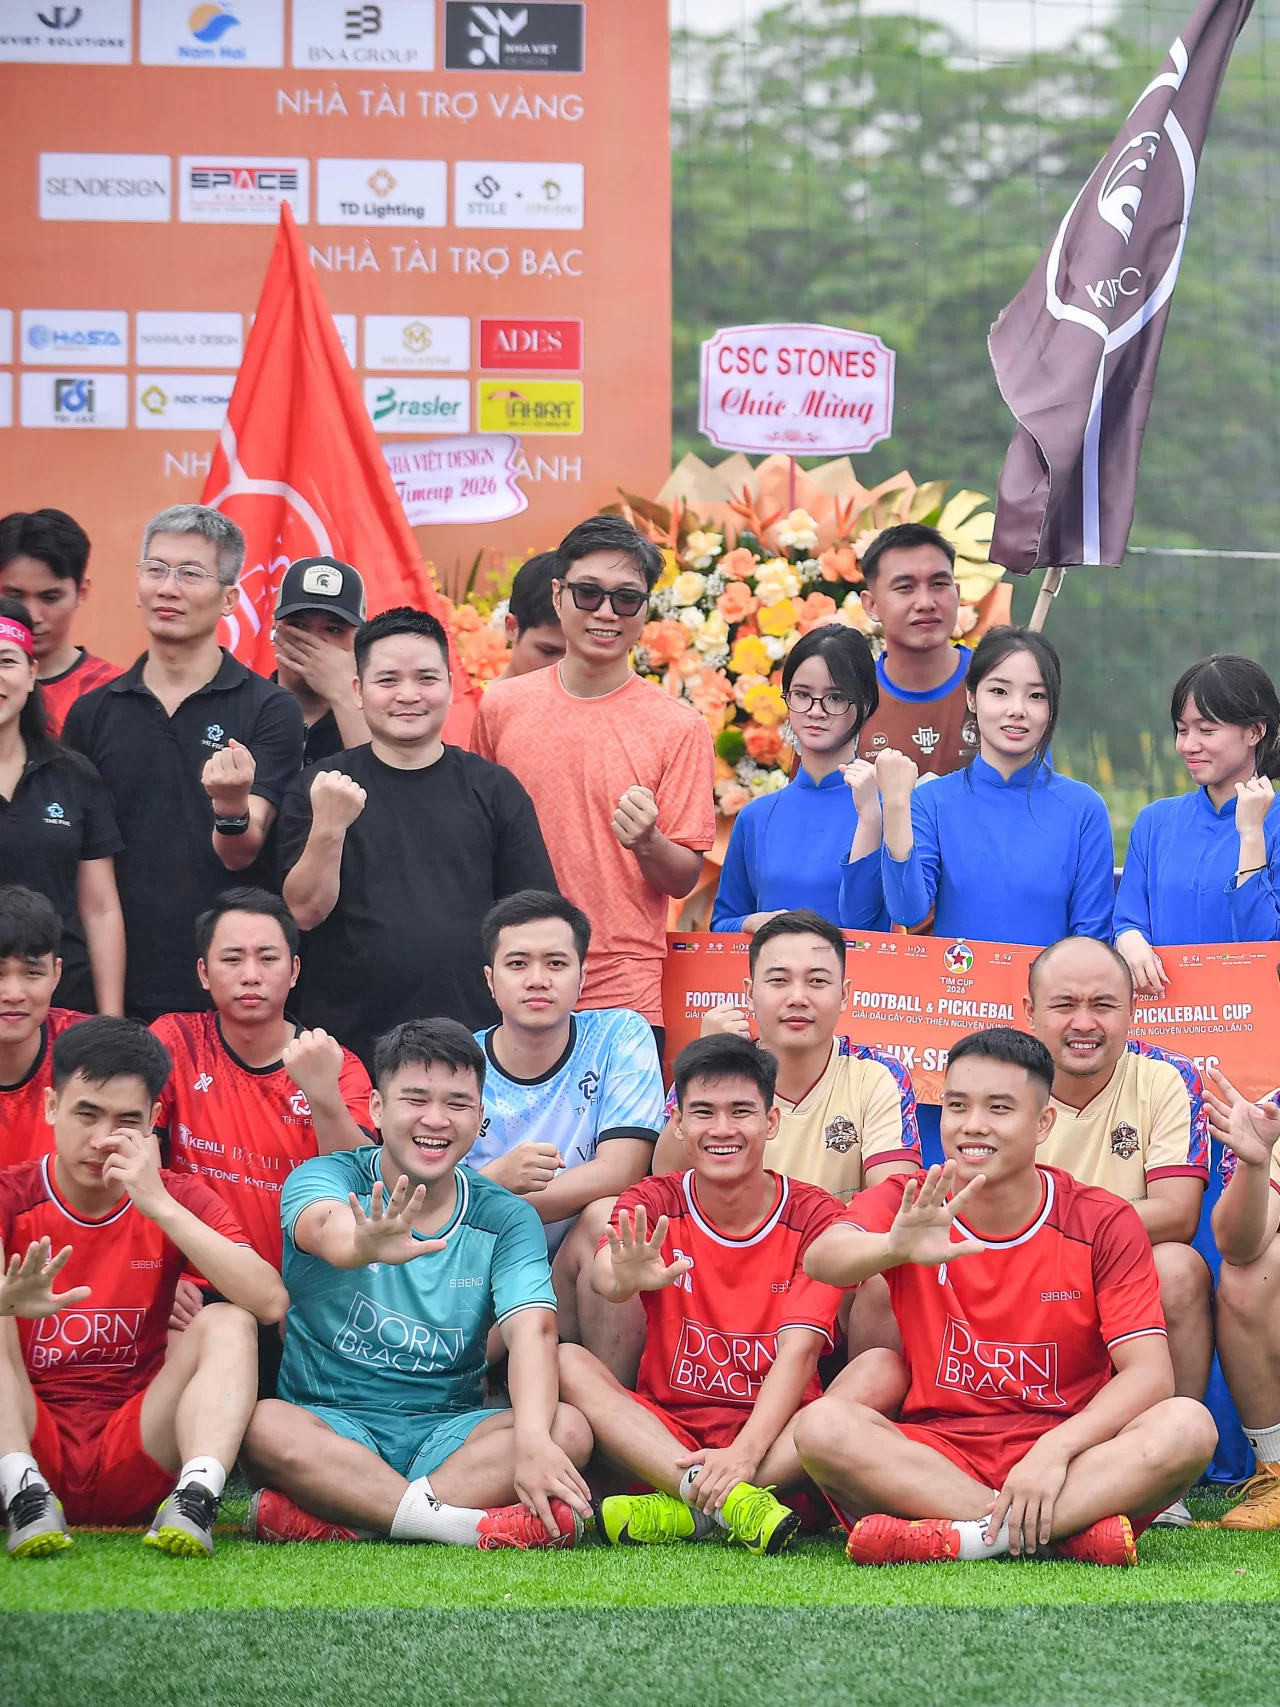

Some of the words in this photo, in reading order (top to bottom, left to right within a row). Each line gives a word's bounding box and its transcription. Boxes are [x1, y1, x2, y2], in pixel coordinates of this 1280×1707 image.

[353, 48, 418, 65] GROUP
[276, 82, 348, 116] NHÀ
[359, 83, 406, 117] TÀI
[417, 88, 479, 124] TRỢ
[489, 85, 585, 121] VÀNG
[46, 177, 166, 198] SENDESIGN
[339, 202, 360, 215] TD
[365, 203, 425, 219] Lighting
[309, 237, 380, 272] NHÀ
[390, 238, 437, 273] TÀI
[448, 246, 511, 279] TRỢ
[521, 247, 583, 279] BẠC
[493, 328, 563, 353] ADES
[718, 346, 768, 374] CSC
[777, 347, 876, 378] STONES
[448, 447, 495, 470] DESIGN
[460, 476, 497, 498] 2026
[940, 976, 956, 985] TIM
[957, 978, 974, 987] CUP
[946, 986, 966, 994] 2026
[852, 990, 922, 1012] FOOTBALL
[926, 1003, 934, 1014] &
[938, 998, 1015, 1021] PICKLEBAL
[1133, 1005, 1219, 1024] PICKLEBALL
[1222, 1003, 1253, 1021] CUP
[925, 1017, 949, 1027] THIỆN
[951, 1019, 985, 1030] NGUYỆN
[1148, 1025, 1181, 1036] NGUYỆN
[1183, 1025, 1206, 1034] VÙNG
[1208, 1024, 1225, 1033] CAO
[1244, 1023, 1253, 1031] 10
[281, 1115, 301, 1125] THE
[188, 1137, 226, 1154] KENLI
[200, 1167, 240, 1183] STONE
[36, 1313, 141, 1346] DORN
[353, 1299, 460, 1361] DORN
[683, 1324, 778, 1371] DORN
